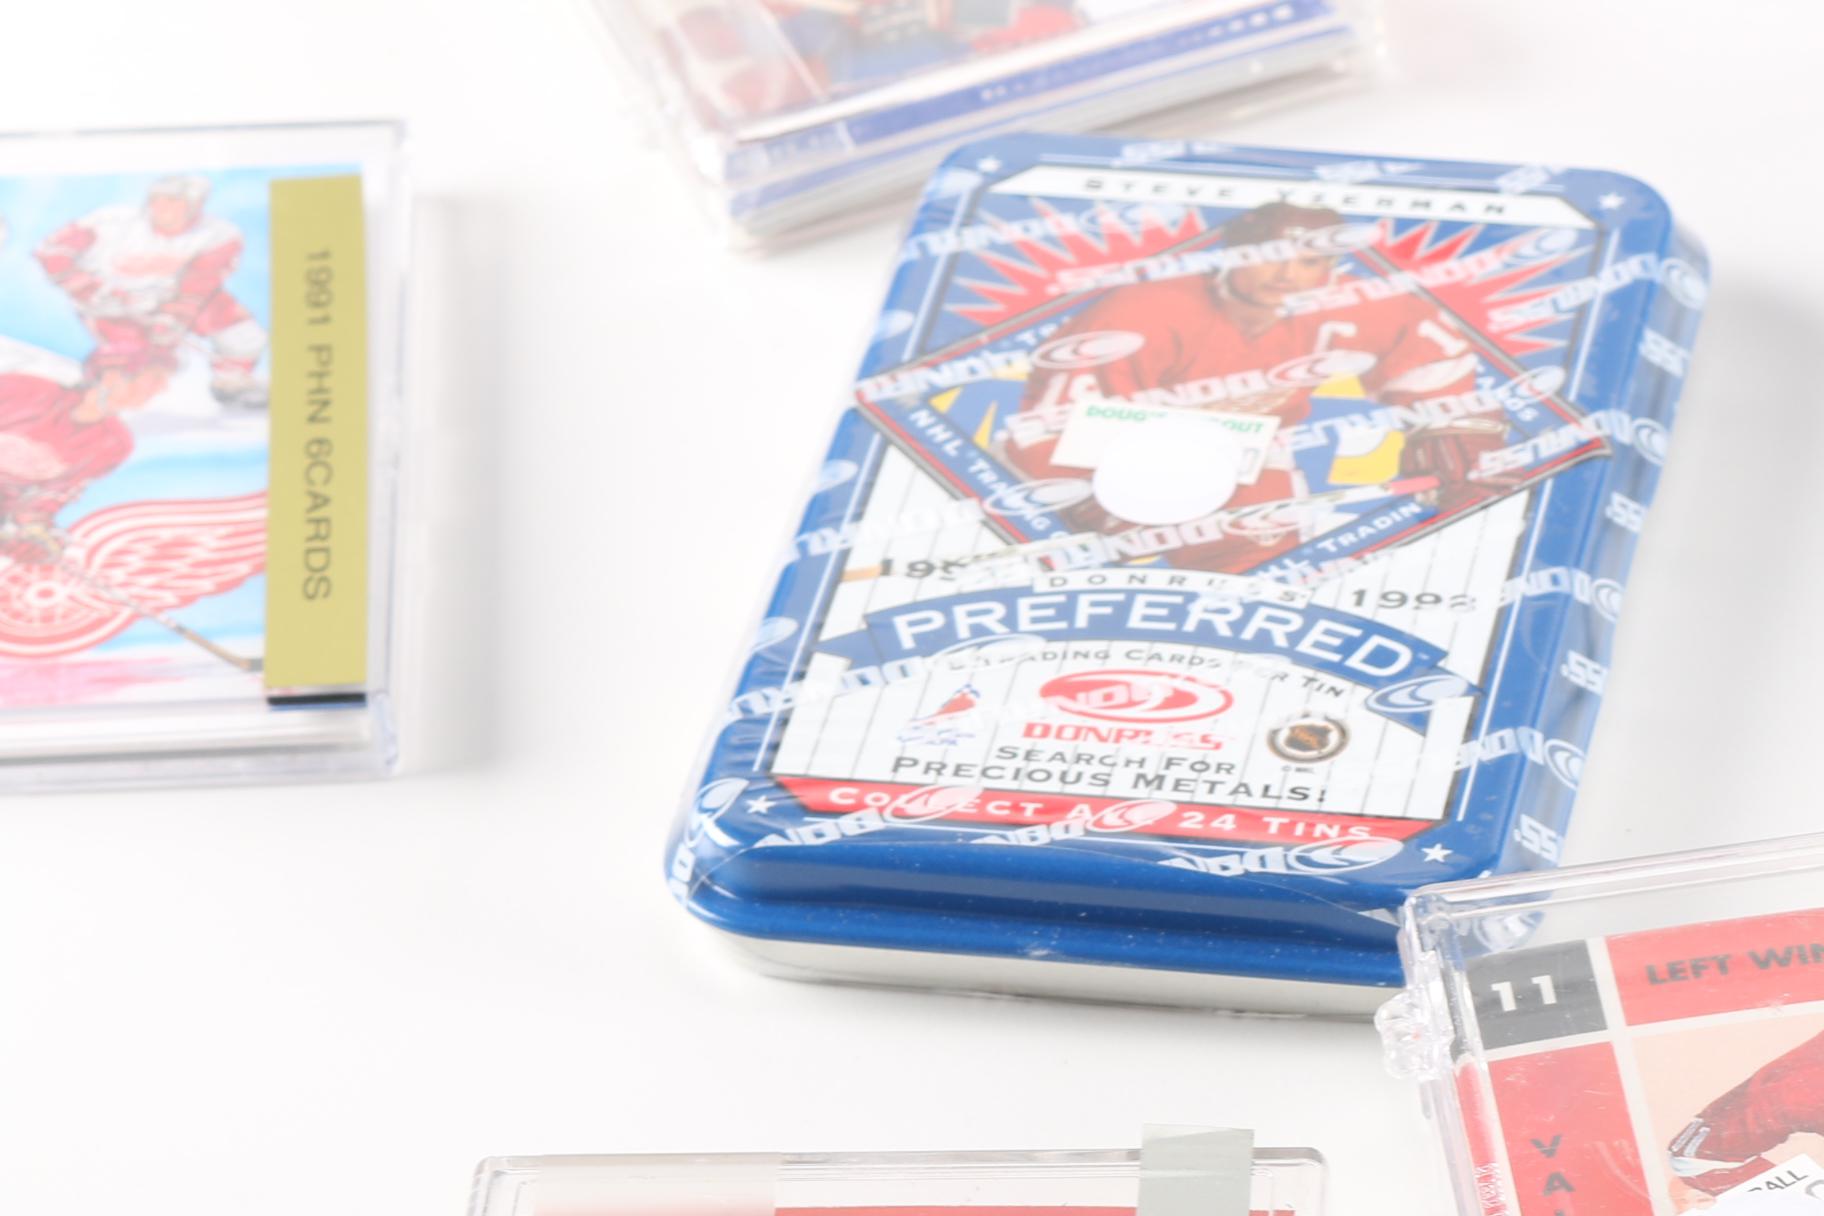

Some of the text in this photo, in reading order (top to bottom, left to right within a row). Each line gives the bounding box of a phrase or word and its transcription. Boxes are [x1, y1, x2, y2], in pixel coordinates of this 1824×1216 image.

[1084, 178, 1235, 198] STEVE
[304, 247, 333, 328] 1991
[306, 342, 334, 423] PHN
[909, 406, 960, 457] NHL
[1316, 501, 1424, 554] TRADIN
[892, 592, 1414, 678] PREFERRED
[1299, 674, 1346, 699] TIN
[889, 755, 1330, 804] PRECIOUS METALS!
[995, 744, 1238, 778] SEARCH FOR
[1177, 812, 1238, 832] 24
[1263, 816, 1375, 841] TINS
[1645, 953, 1737, 987] LEFT
[1491, 974, 1559, 1013] 11
